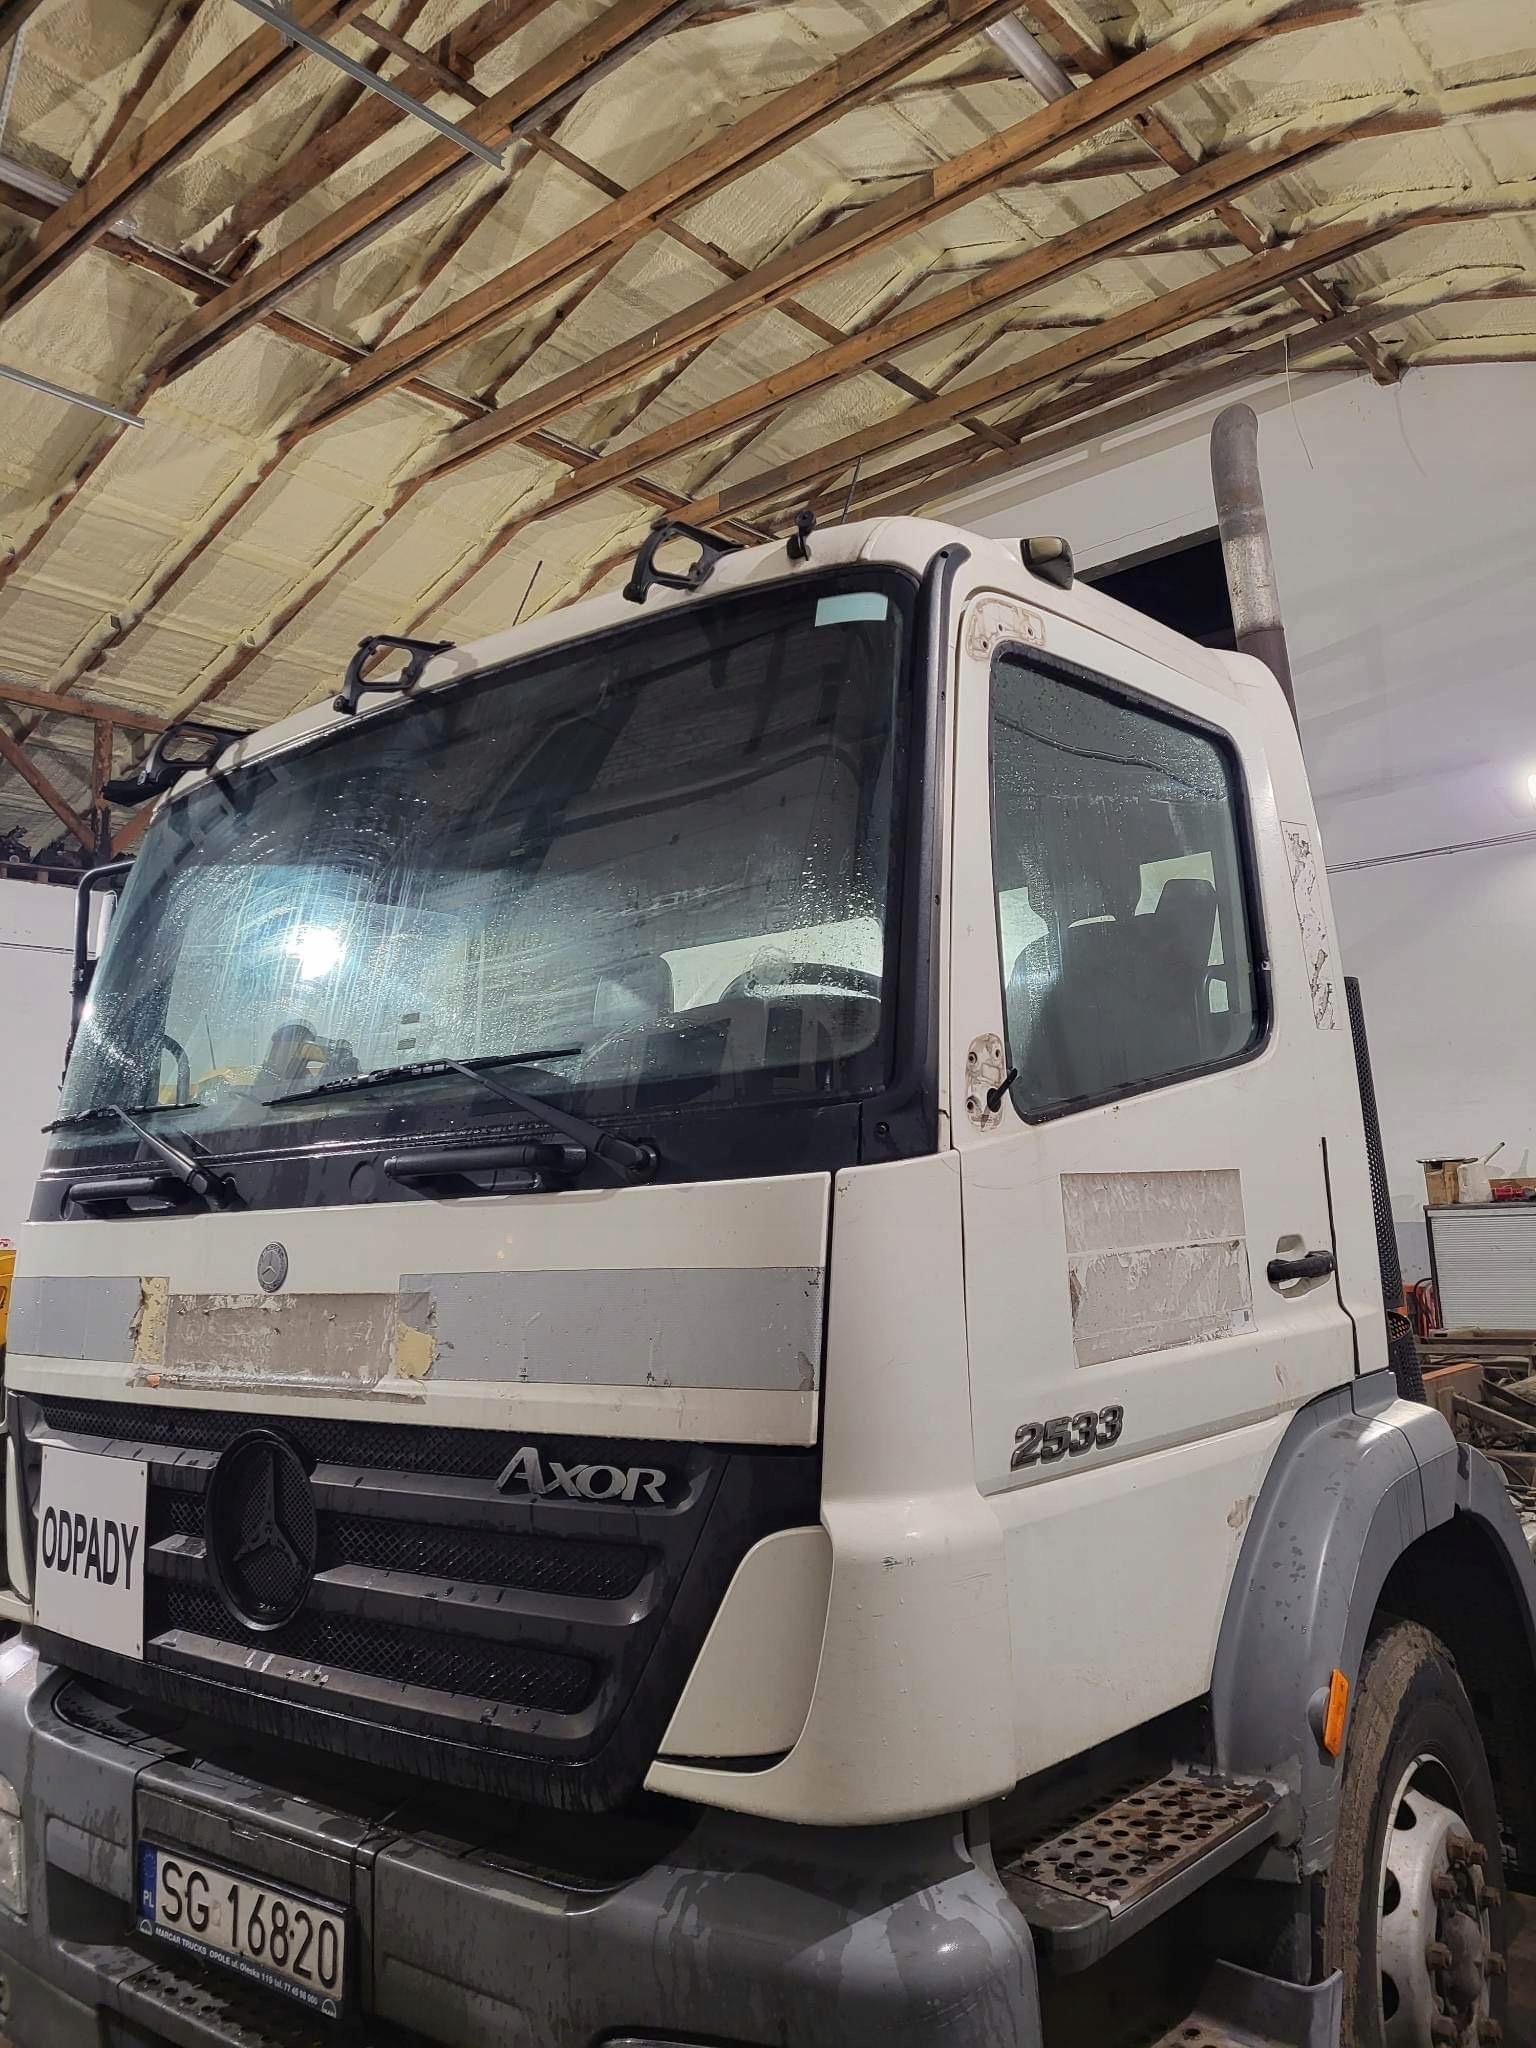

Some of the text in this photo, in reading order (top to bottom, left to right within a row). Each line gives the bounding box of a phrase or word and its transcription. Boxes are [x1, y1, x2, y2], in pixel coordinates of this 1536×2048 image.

[1010, 1404, 1124, 1472] 2533
[42, 1506, 139, 1590] ODPADY
[143, 1890, 155, 1909] PL
[161, 1860, 339, 1990] SG 16820
[155, 1927, 181, 1945] MARCAR
[182, 1938, 207, 1955] TRUCKS
[209, 1950, 231, 1966] OPOLE
